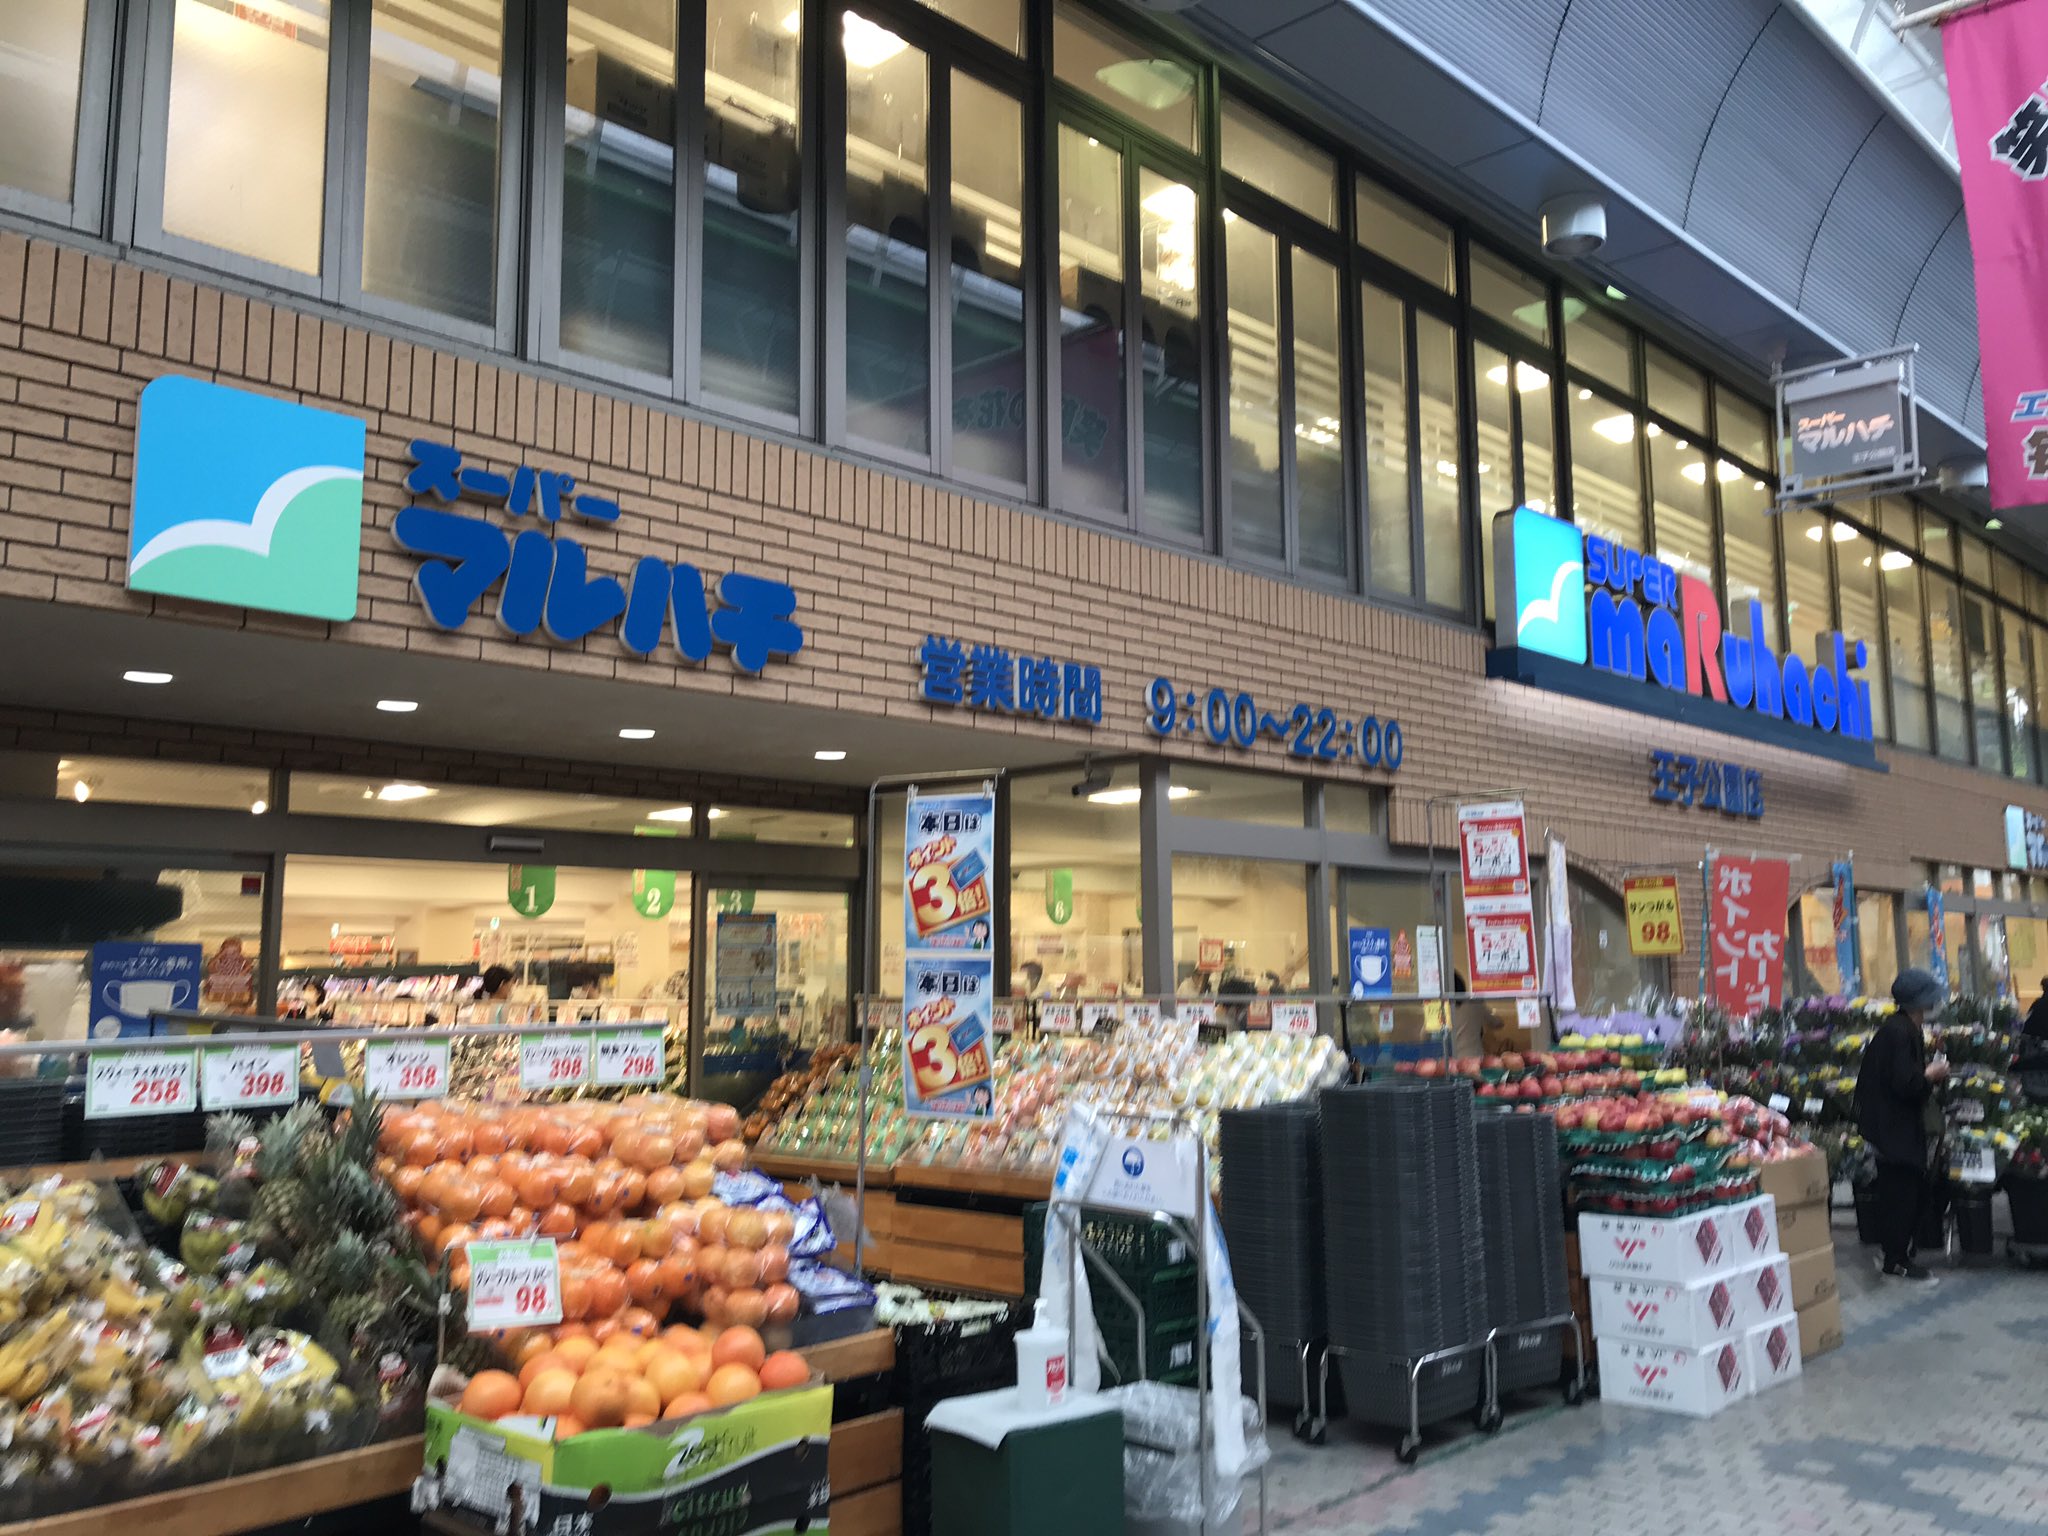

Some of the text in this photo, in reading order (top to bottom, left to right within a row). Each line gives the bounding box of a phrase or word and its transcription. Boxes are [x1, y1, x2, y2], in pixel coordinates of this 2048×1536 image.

[1798, 413, 1895, 454] マルハチ
[408, 437, 621, 524] スーパー
[1587, 533, 1678, 609] SUPER
[392, 504, 804, 674] マルハチ
[917, 635, 1102, 725] 営業時間
[919, 809, 982, 835] 本日は
[908, 834, 957, 870] ポイント
[524, 885, 538, 913] 1
[646, 888, 662, 914] 2
[1055, 900, 1065, 922] 6
[1641, 921, 1670, 944] 98
[919, 969, 980, 997] 本日は
[907, 995, 957, 1033] ポイント
[229, 1057, 270, 1074] パイン
[386, 1051, 430, 1064] オレンジ
[549, 1056, 583, 1081] 398
[622, 1055, 655, 1078] 298
[130, 1078, 181, 1105] 258
[240, 1072, 286, 1098] 398
[515, 1282, 548, 1315] 98
